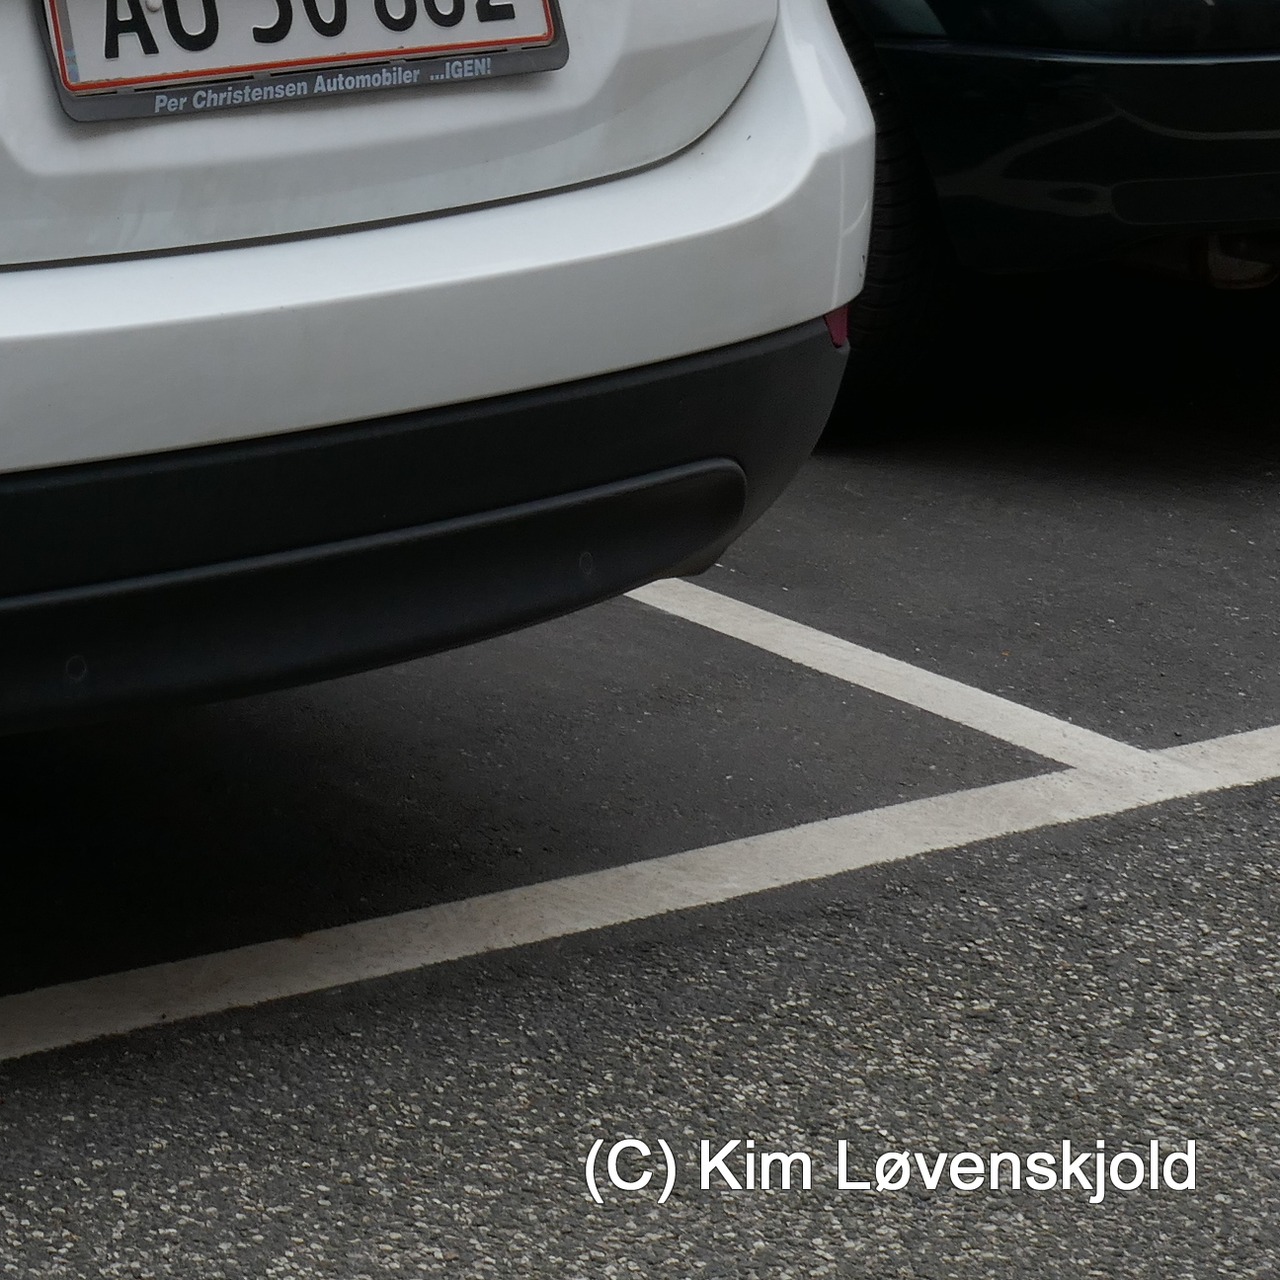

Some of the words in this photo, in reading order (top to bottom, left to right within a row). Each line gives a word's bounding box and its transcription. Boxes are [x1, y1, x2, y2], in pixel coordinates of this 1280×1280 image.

[153, 94, 189, 114] Per
[192, 81, 309, 111] Christensen
[313, 66, 421, 95] Automobiler
